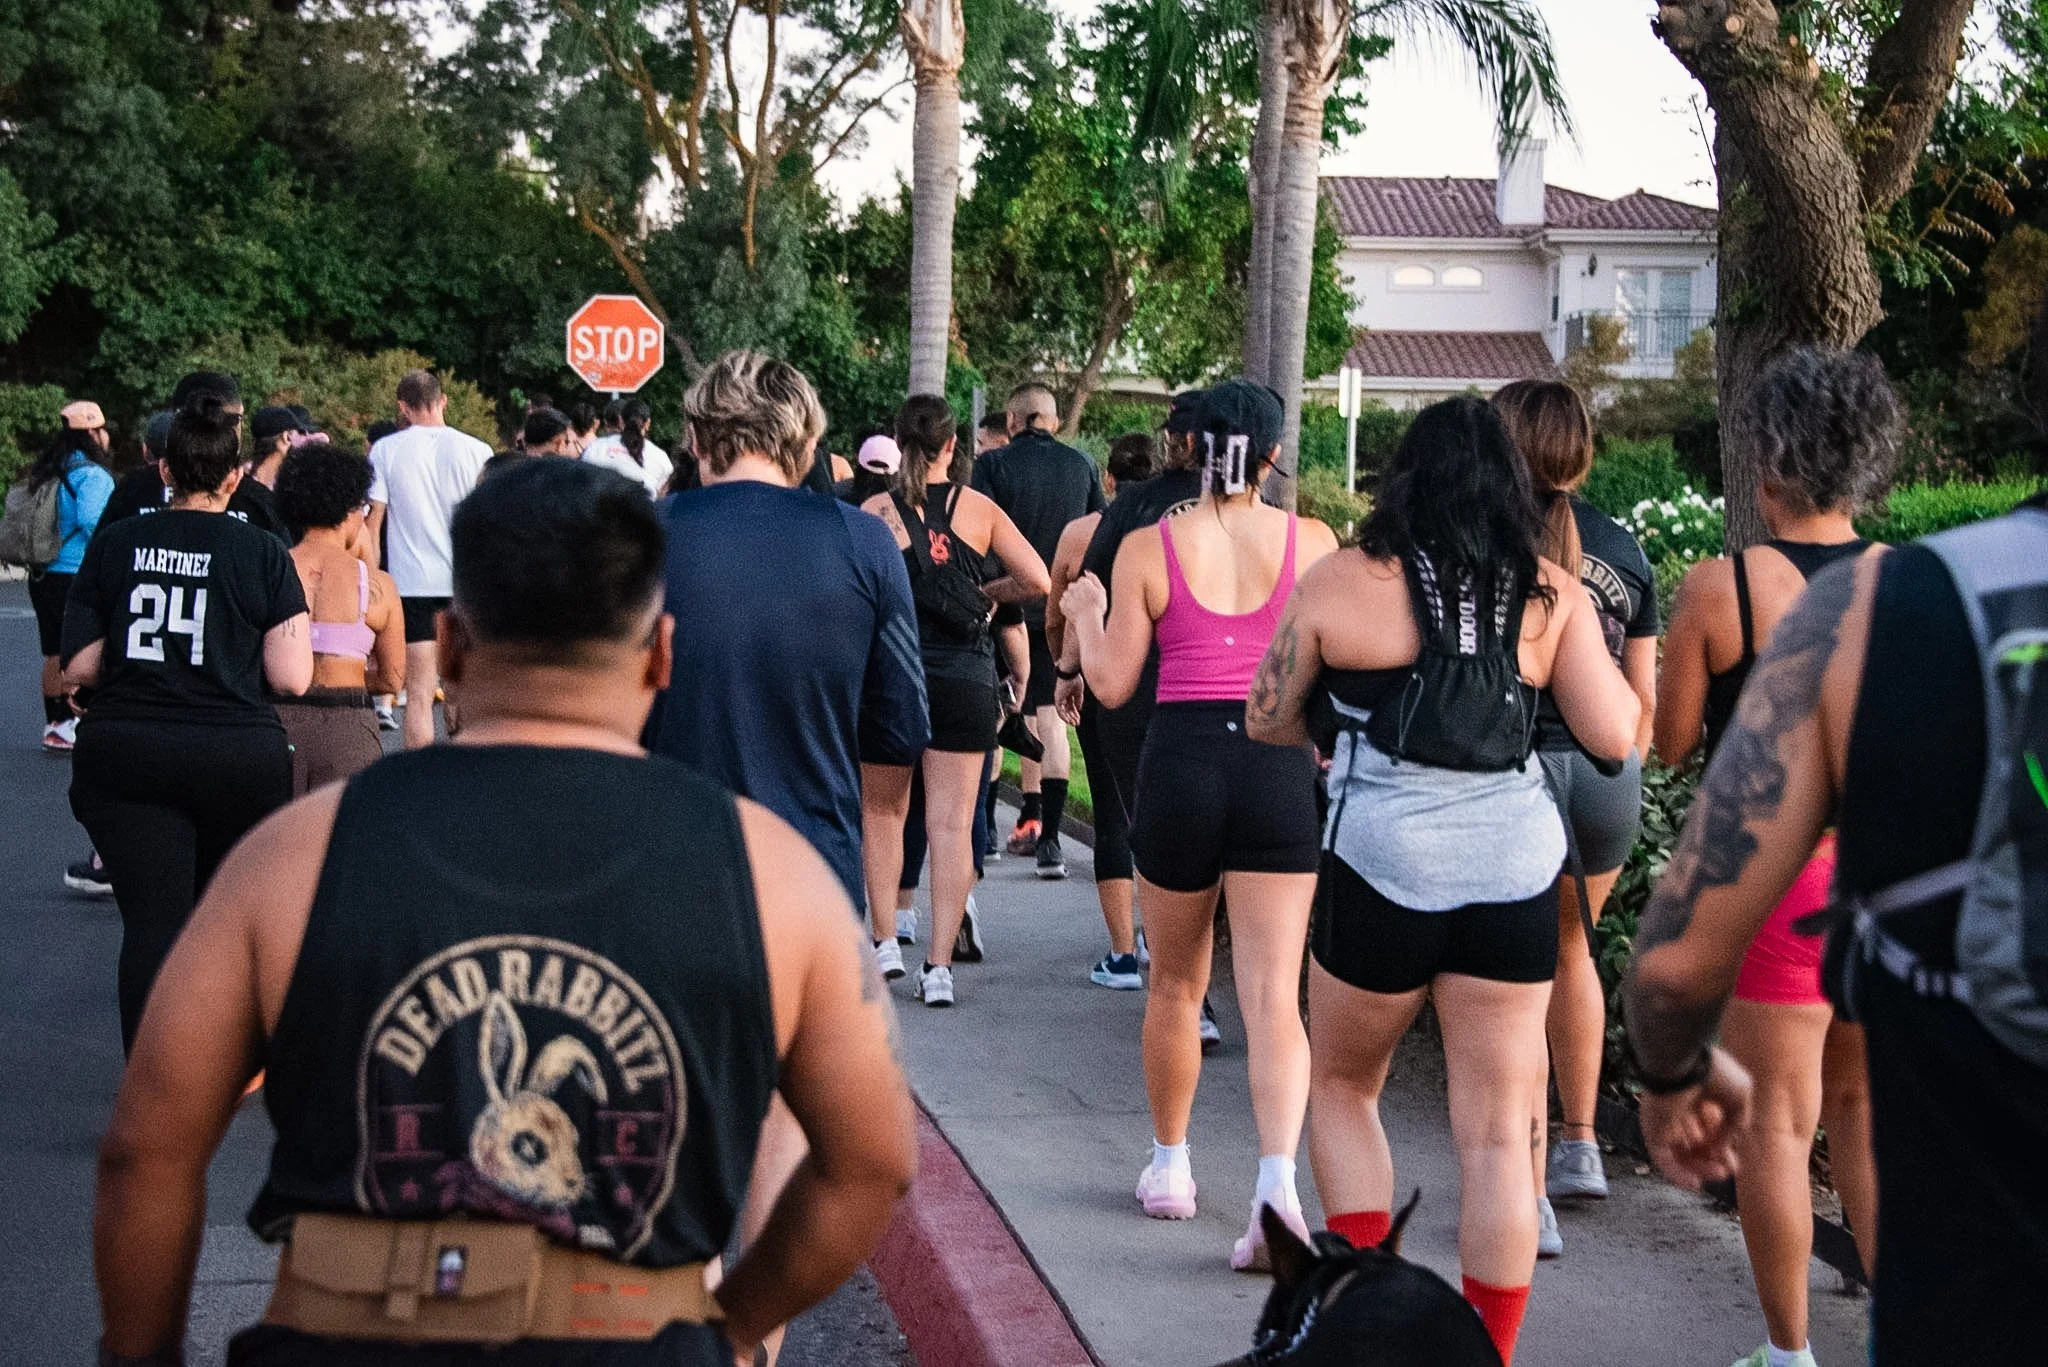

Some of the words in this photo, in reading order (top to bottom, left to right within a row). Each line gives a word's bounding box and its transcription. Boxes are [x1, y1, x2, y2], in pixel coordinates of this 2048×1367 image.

[575, 325, 658, 363] STOP
[133, 547, 211, 577] MARTINEZ
[1581, 559, 1625, 607] BBITZ
[126, 583, 207, 666] 24
[377, 957, 489, 1077] DEAD
[499, 949, 670, 1094] RABBITZ
